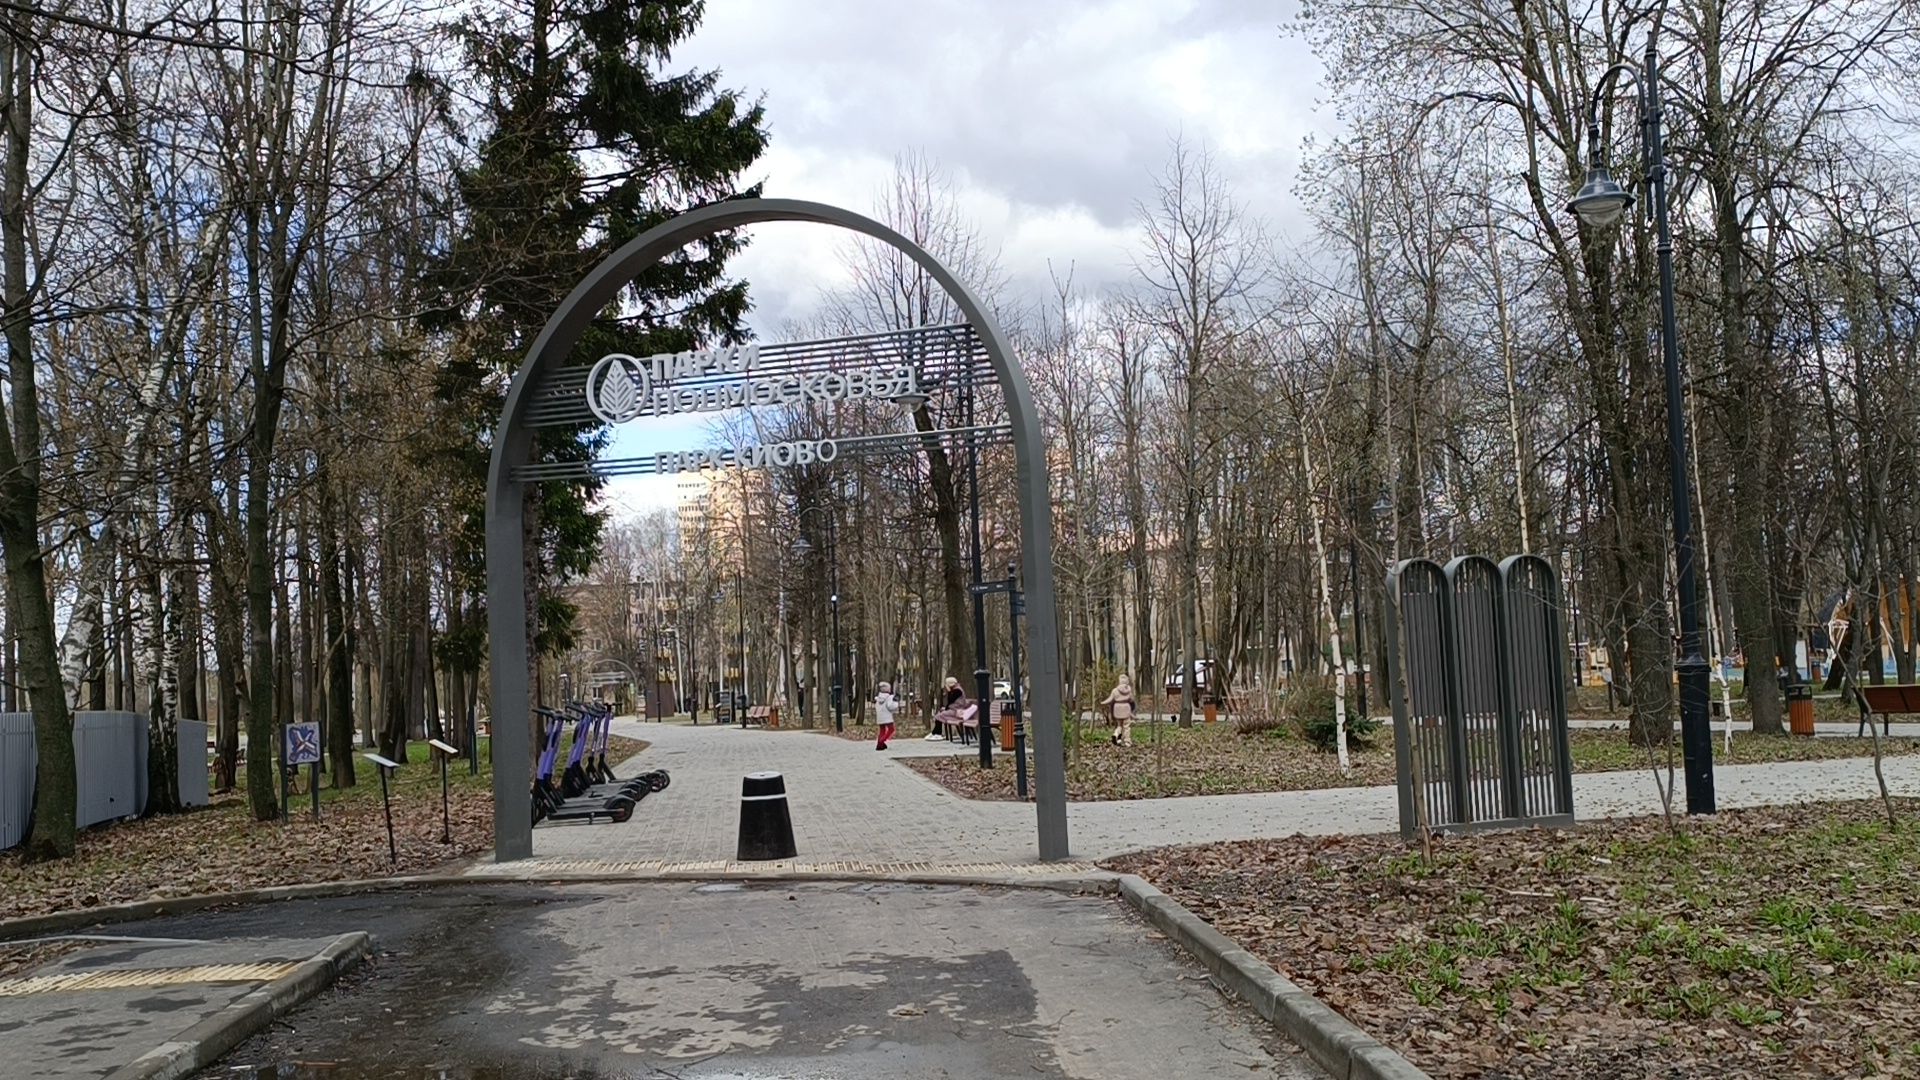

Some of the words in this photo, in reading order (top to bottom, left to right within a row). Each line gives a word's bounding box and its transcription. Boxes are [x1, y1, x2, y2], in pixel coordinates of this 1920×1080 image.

[651, 344, 760, 380] ПАРКИ
[652, 365, 917, 417] ПОДМОСКОВЬЯ
[655, 447, 726, 475] ПАРК
[733, 438, 838, 470] КИОВО
